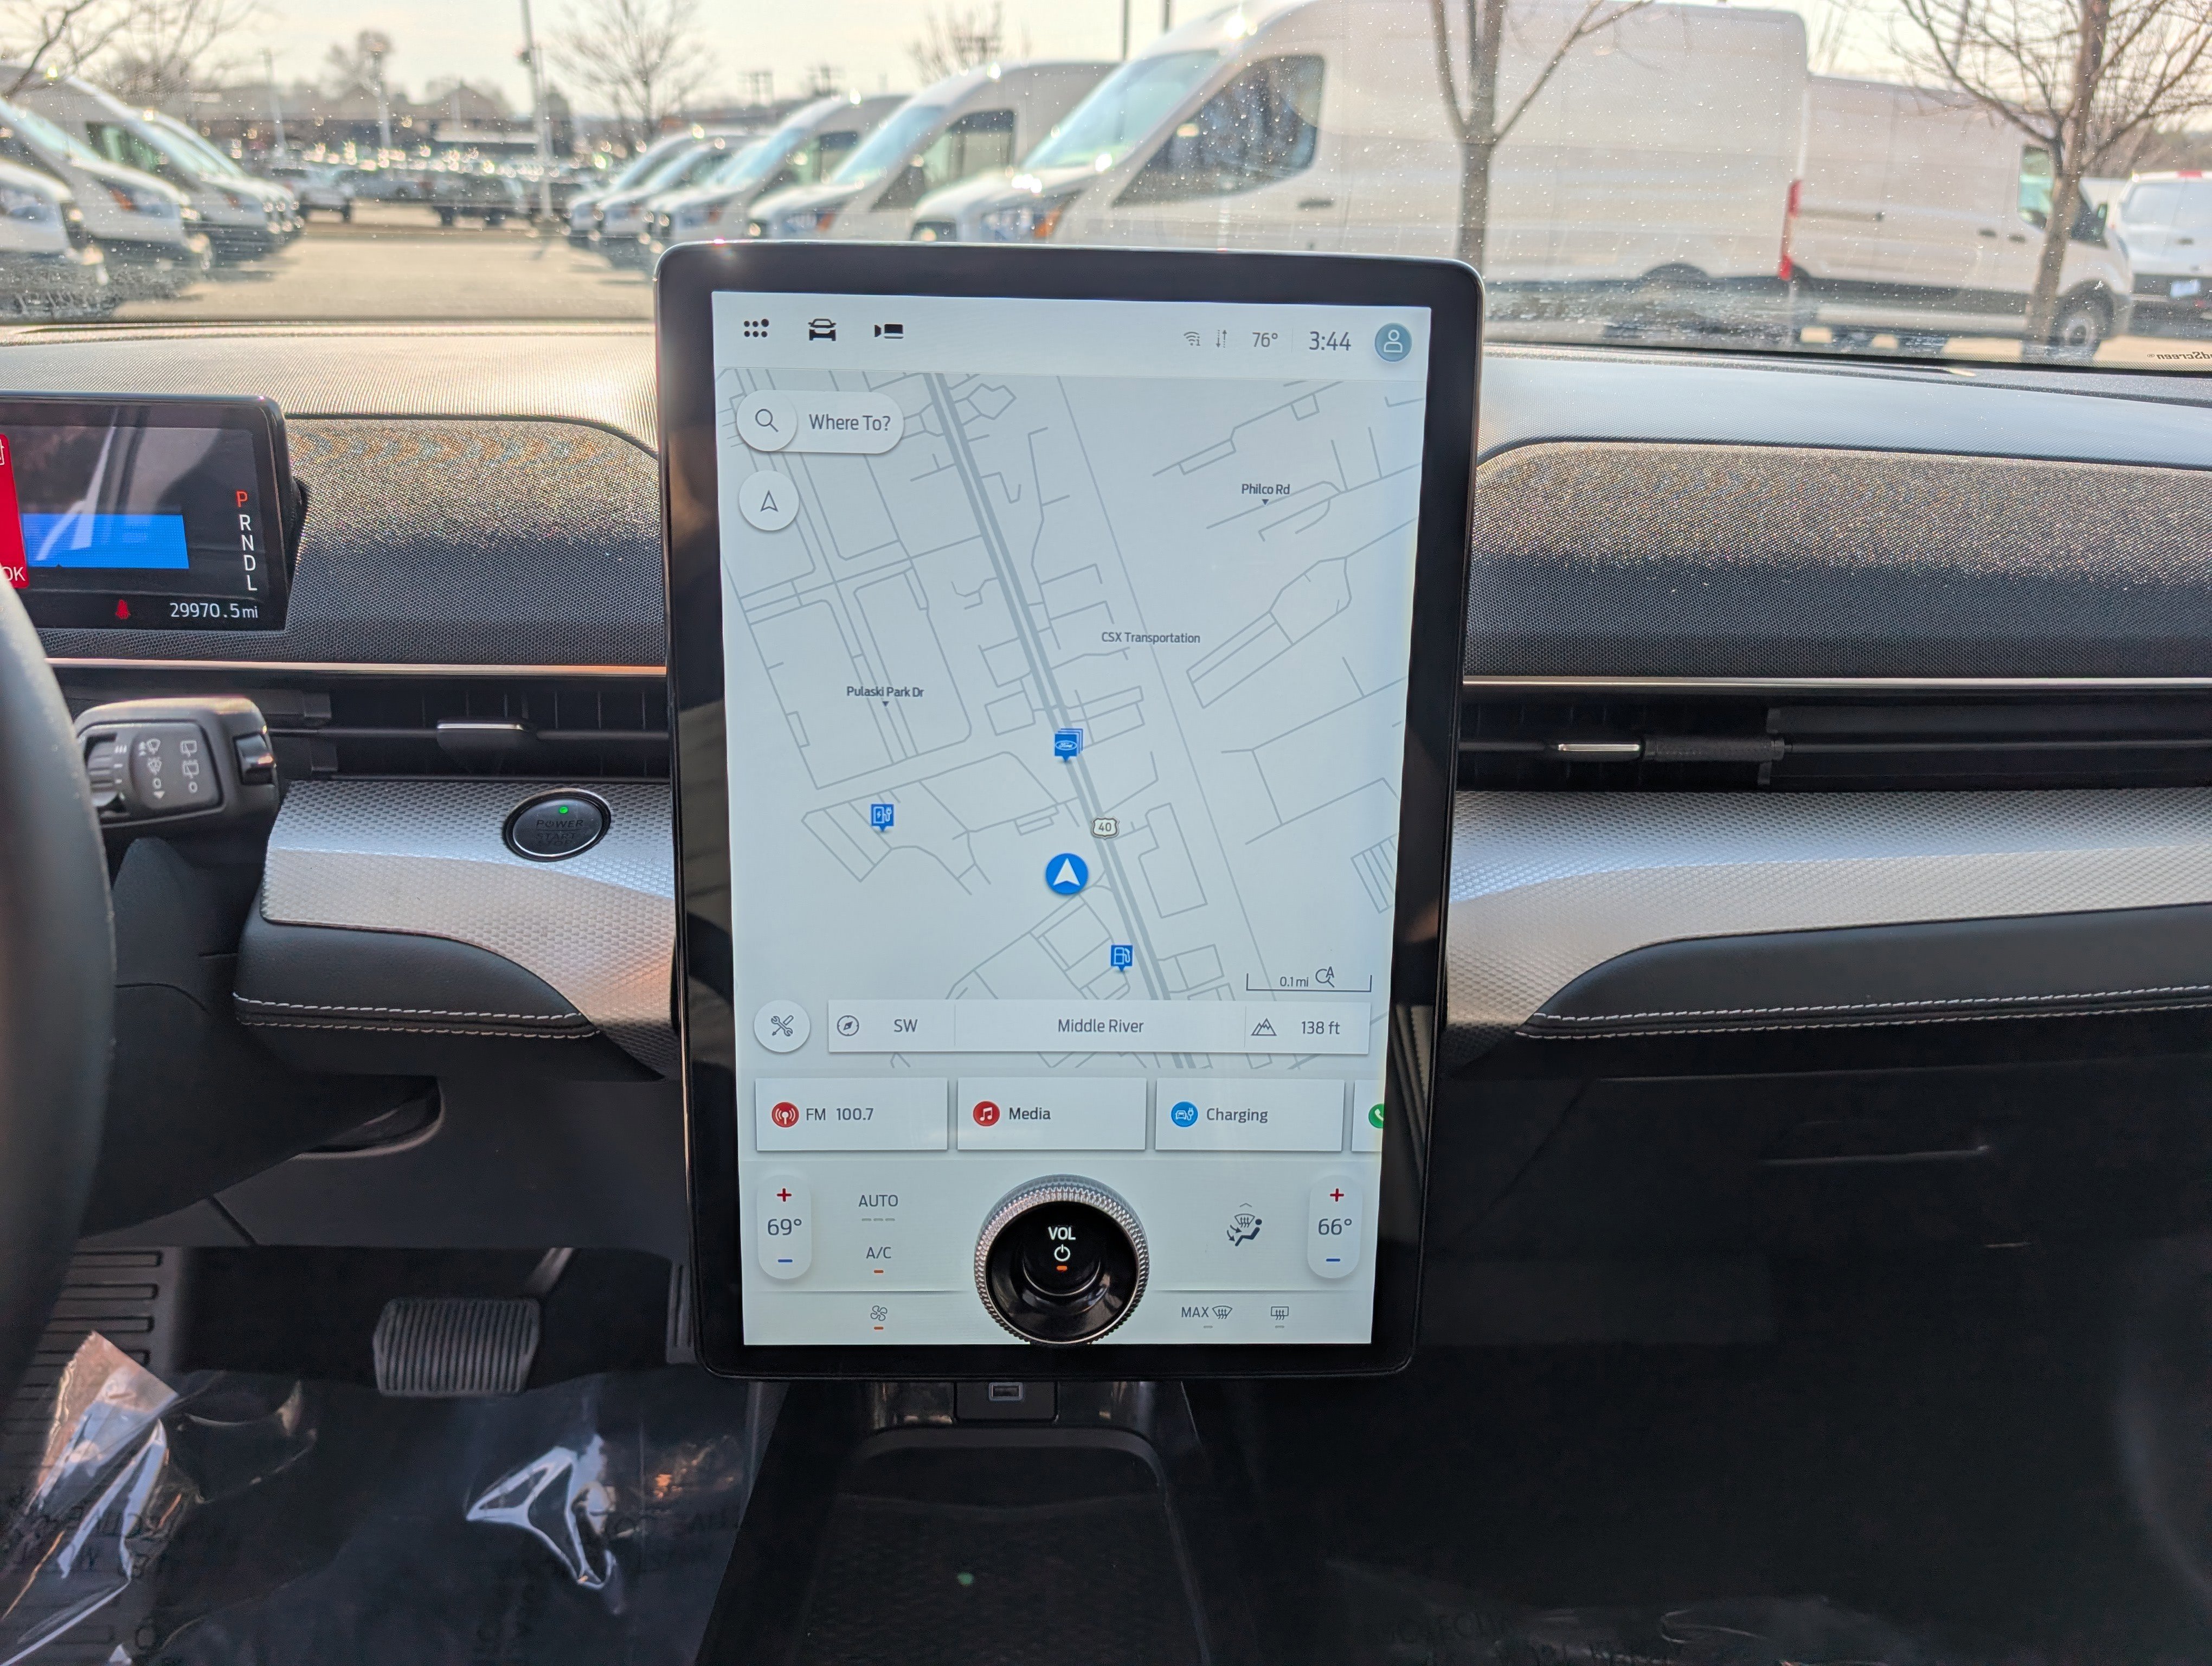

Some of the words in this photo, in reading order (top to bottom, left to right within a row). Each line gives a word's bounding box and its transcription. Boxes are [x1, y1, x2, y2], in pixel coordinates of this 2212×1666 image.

[1309, 331, 1352, 351] 3:44
[809, 413, 859, 431] Where
[862, 415, 891, 431] To?
[1242, 483, 1272, 495] Philco
[1276, 483, 1290, 495] Rd
[236, 490, 248, 508] P
[239, 514, 252, 531] R
[241, 534, 254, 551] N
[243, 554, 256, 571] D
[2, 566, 25, 581] OK
[247, 575, 258, 591] L
[1102, 632, 1122, 643] CSX
[1124, 632, 1200, 645] Transportation
[847, 685, 884, 697] Pulaski
[886, 686, 911, 697] Park
[912, 687, 924, 697] Dr
[536, 819, 583, 828] POWER
[1099, 822, 1112, 832] 40
[893, 1018, 918, 1033] SW
[1058, 1018, 1105, 1033] Middle
[1109, 1019, 1144, 1033] River
[1301, 1021, 1324, 1035] 138
[1328, 1021, 1340, 1035] ft
[806, 1108, 826, 1121] FM
[836, 1107, 874, 1121] 100.7
[1009, 1107, 1051, 1120] Media
[1206, 1107, 1268, 1124] Charging
[858, 1194, 898, 1207] AUTO
[1047, 1226, 1076, 1240] VOL
[866, 1246, 891, 1259] A/C
[1181, 1306, 1209, 1318] MAX
